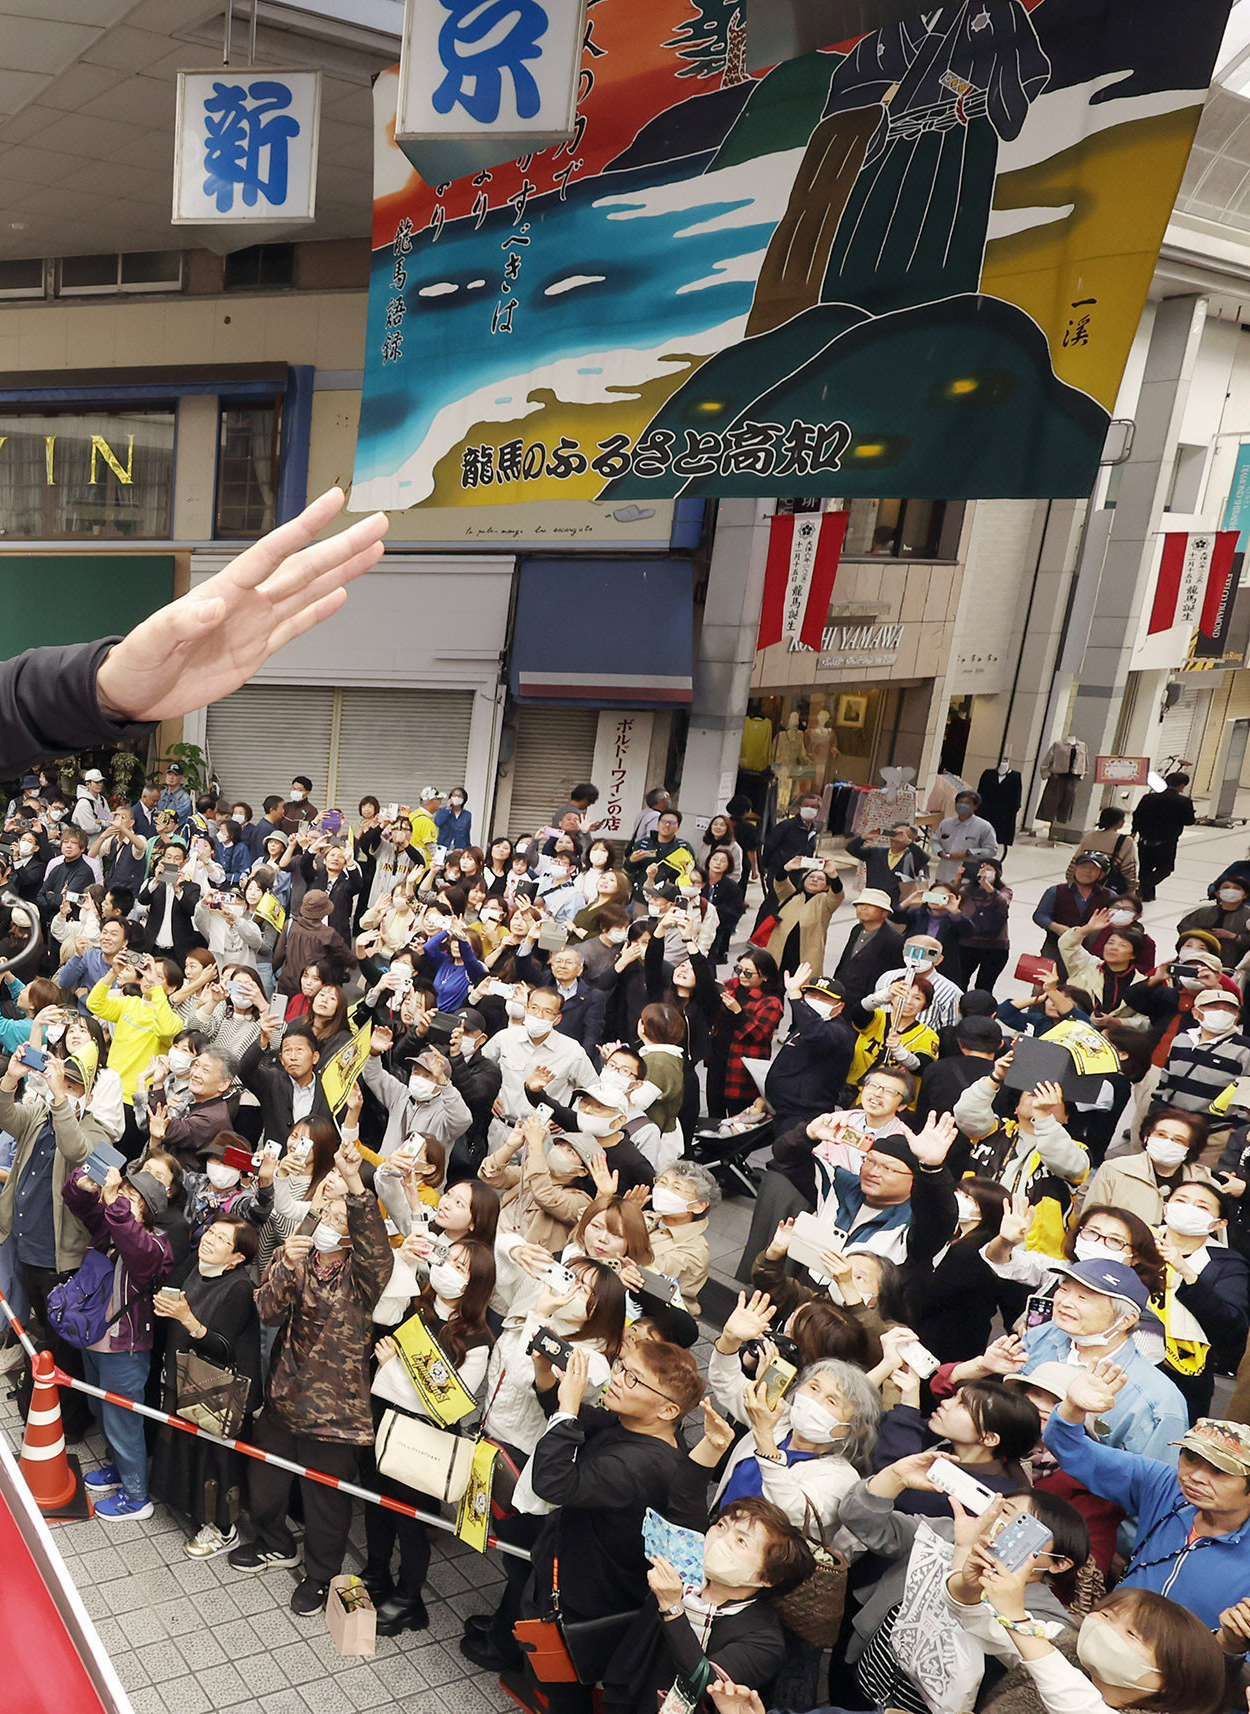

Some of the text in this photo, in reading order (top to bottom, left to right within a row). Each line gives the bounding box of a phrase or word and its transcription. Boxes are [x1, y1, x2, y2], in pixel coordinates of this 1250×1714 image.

[203, 80, 301, 213] 新
[382, 218, 414, 365] 龍馬語録
[461, 419, 852, 489] 龍馬のふるさと高知
[603, 719, 634, 832] ボルドーワインの店
